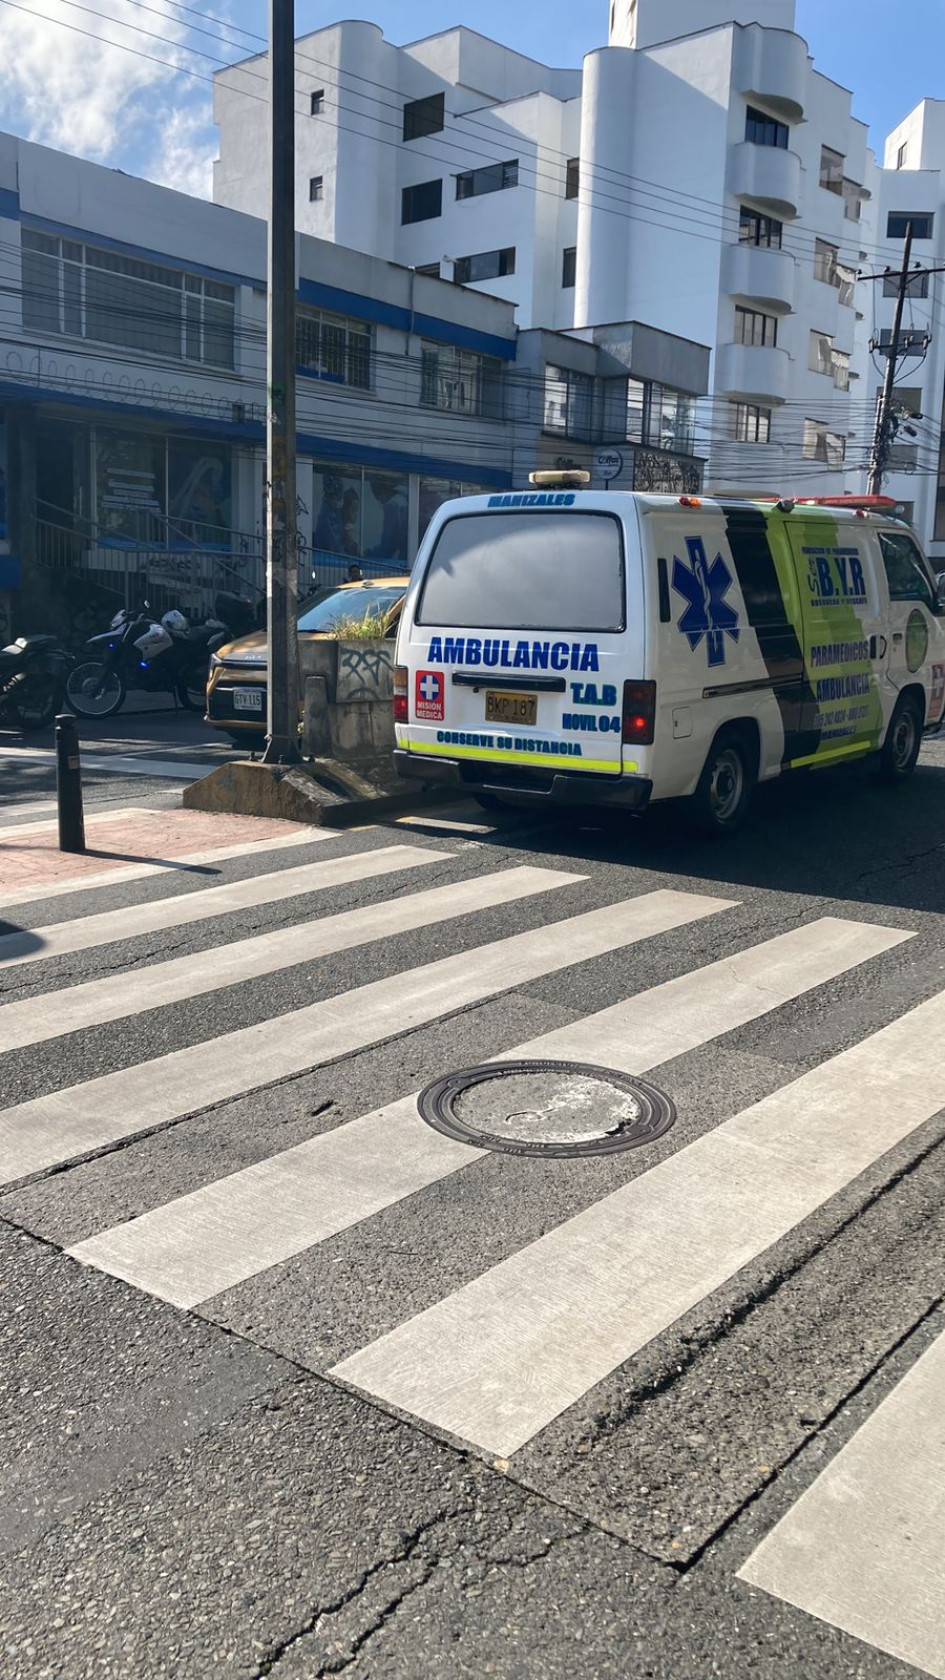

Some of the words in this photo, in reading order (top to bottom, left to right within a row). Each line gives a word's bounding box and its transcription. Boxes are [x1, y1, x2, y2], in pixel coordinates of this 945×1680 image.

[487, 493, 576, 508] MANIZALES
[427, 636, 600, 672] AMBULANCIA
[810, 640, 869, 668] PARAMEDICOS
[816, 673, 870, 703] AMBULANCIA
[416, 710, 443, 720] MEDICA
[417, 701, 442, 711] MISION
[487, 696, 509, 714] BKP
[513, 698, 535, 717] 187
[562, 712, 598, 732] MOVIL
[599, 714, 621, 733] 04
[436, 730, 494, 748] CONSERVE
[496, 736, 513, 750] SU
[514, 738, 583, 757] DISTANCIA
